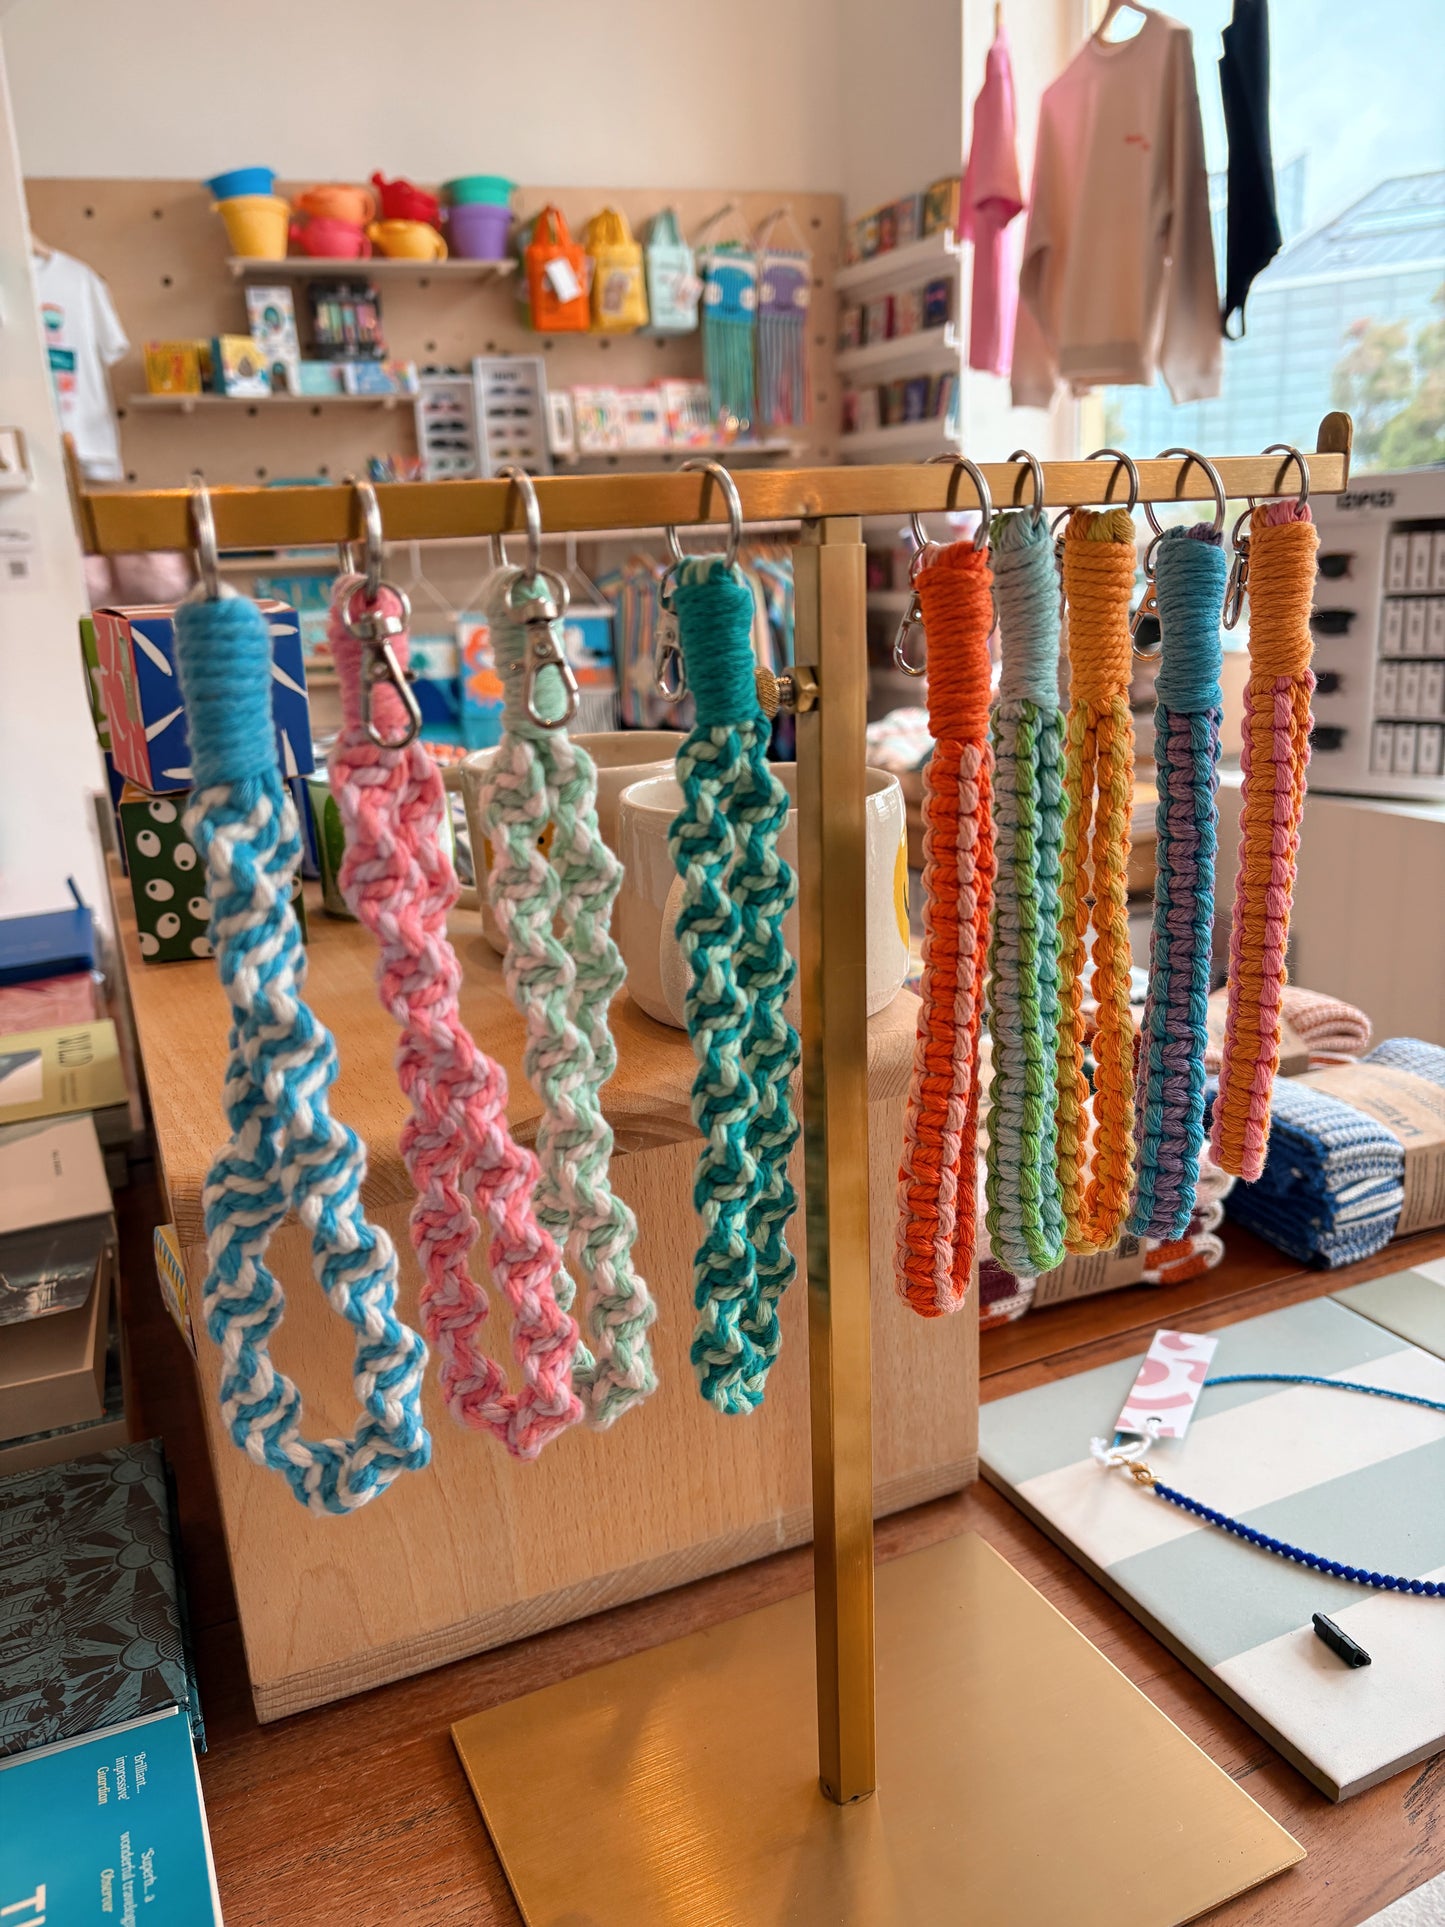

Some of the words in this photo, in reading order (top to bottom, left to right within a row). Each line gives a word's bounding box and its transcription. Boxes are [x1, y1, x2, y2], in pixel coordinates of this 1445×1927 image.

[96, 1766, 110, 1806] Guardian
[120, 1831, 135, 1881] wonderful
[100, 1868, 115, 1913] Observer
